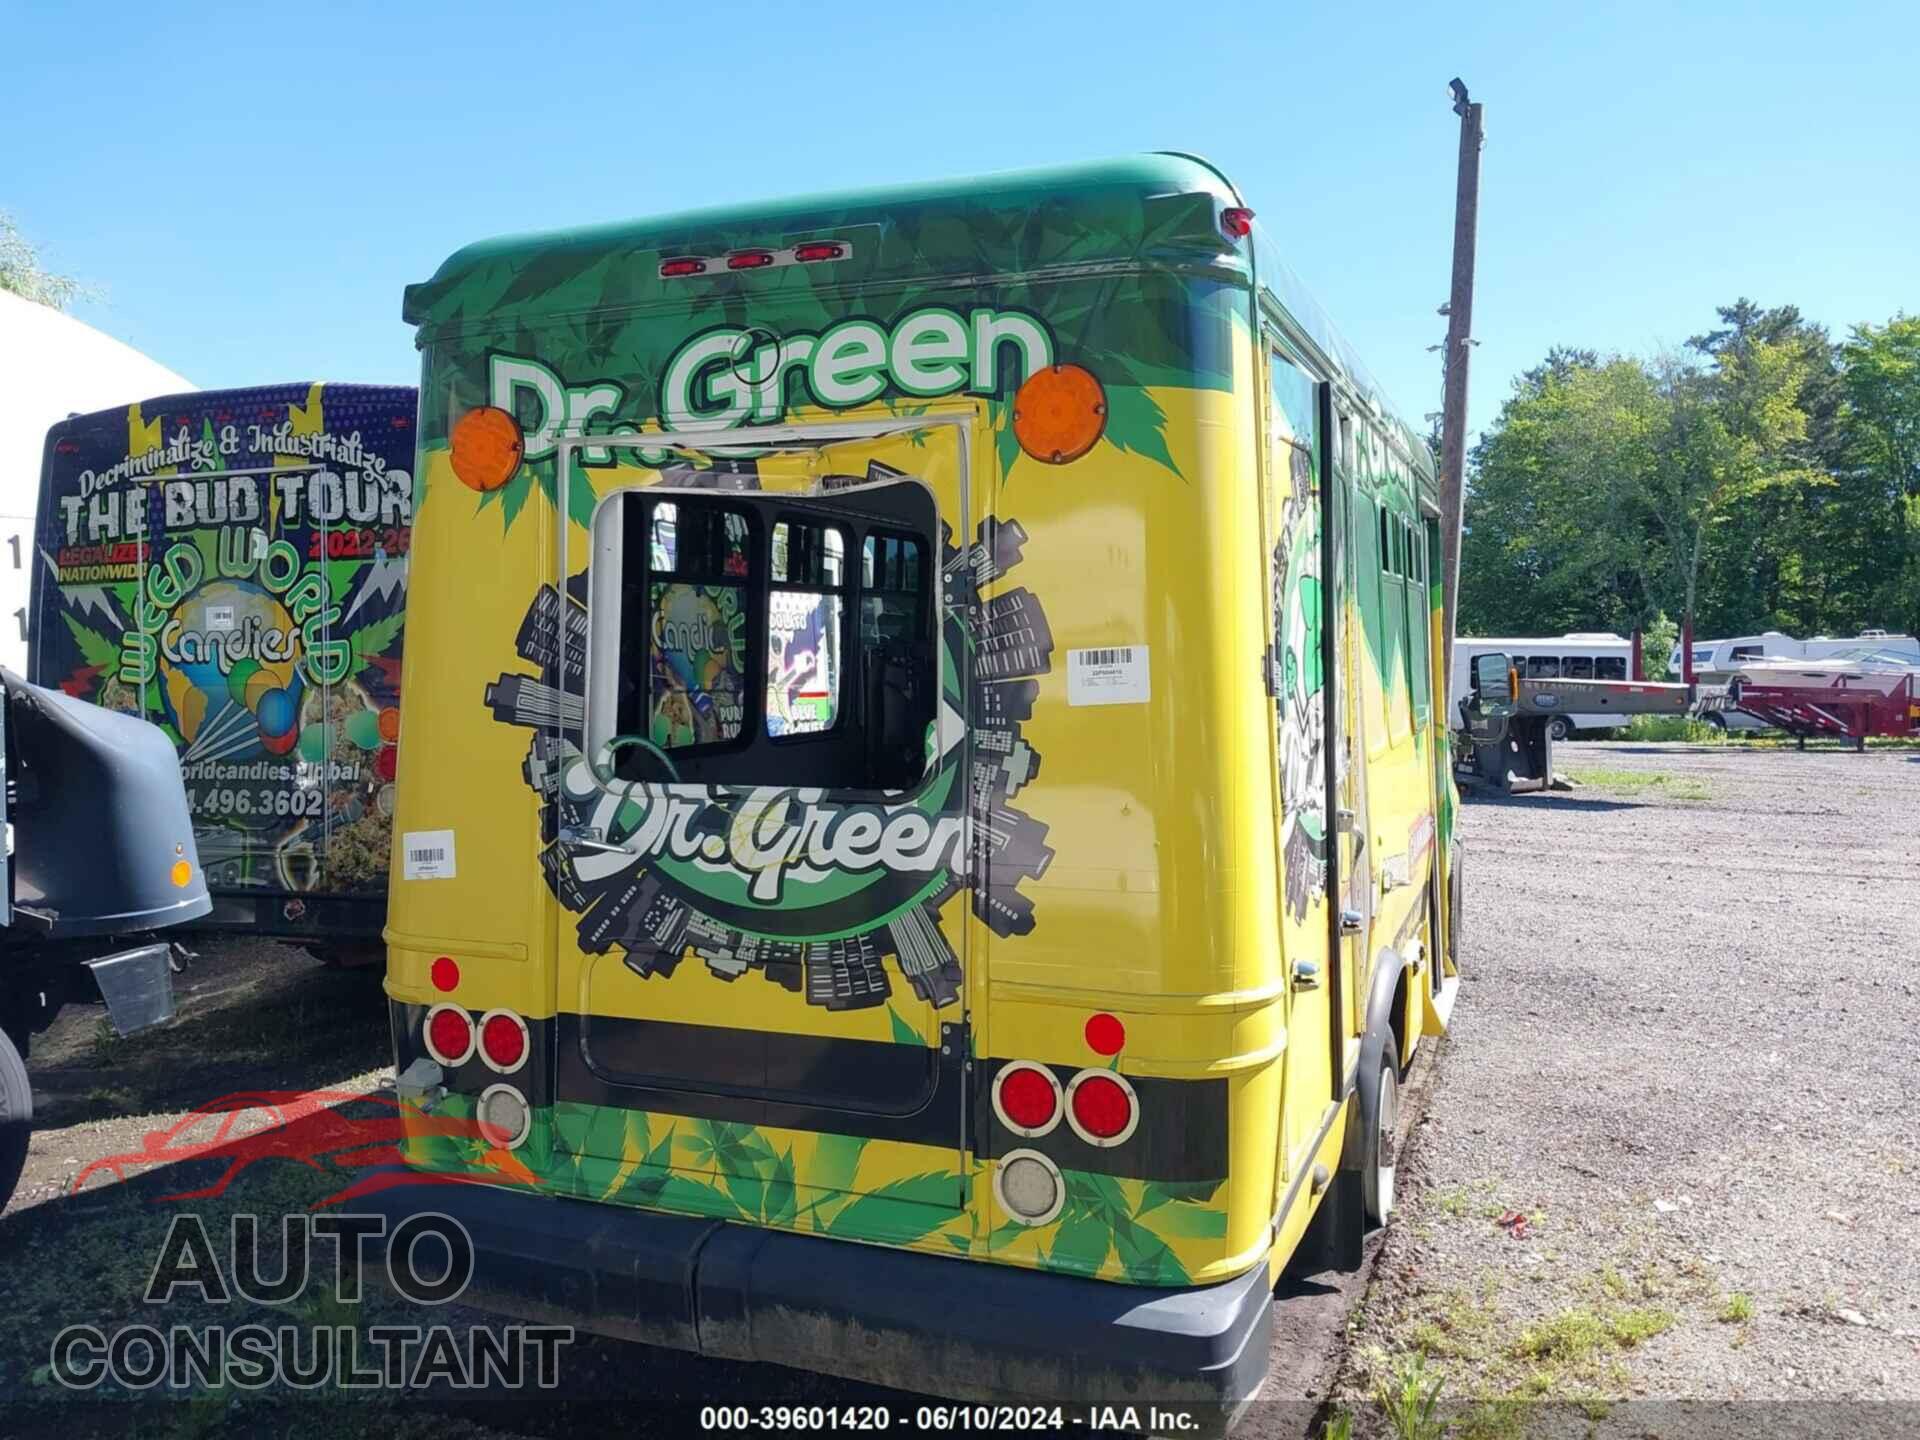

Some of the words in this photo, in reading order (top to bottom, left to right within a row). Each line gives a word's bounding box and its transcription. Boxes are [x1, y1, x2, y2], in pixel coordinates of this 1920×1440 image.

[487, 350, 658, 466] Dr.
[660, 306, 1053, 442] Green
[79, 425, 217, 498] Decriminalize
[219, 425, 240, 455] &
[248, 420, 389, 492] Industrialize
[61, 485, 147, 546] THE
[165, 476, 260, 527] BUD
[277, 469, 412, 526] TOUR
[59, 562, 148, 582] NATIONWID!
[162, 615, 301, 674] Candies
[181, 761, 360, 787] orldcandies.global
[186, 788, 322, 816] 4.496.3602
[573, 784, 725, 881] Dr.
[731, 788, 974, 899] Green
